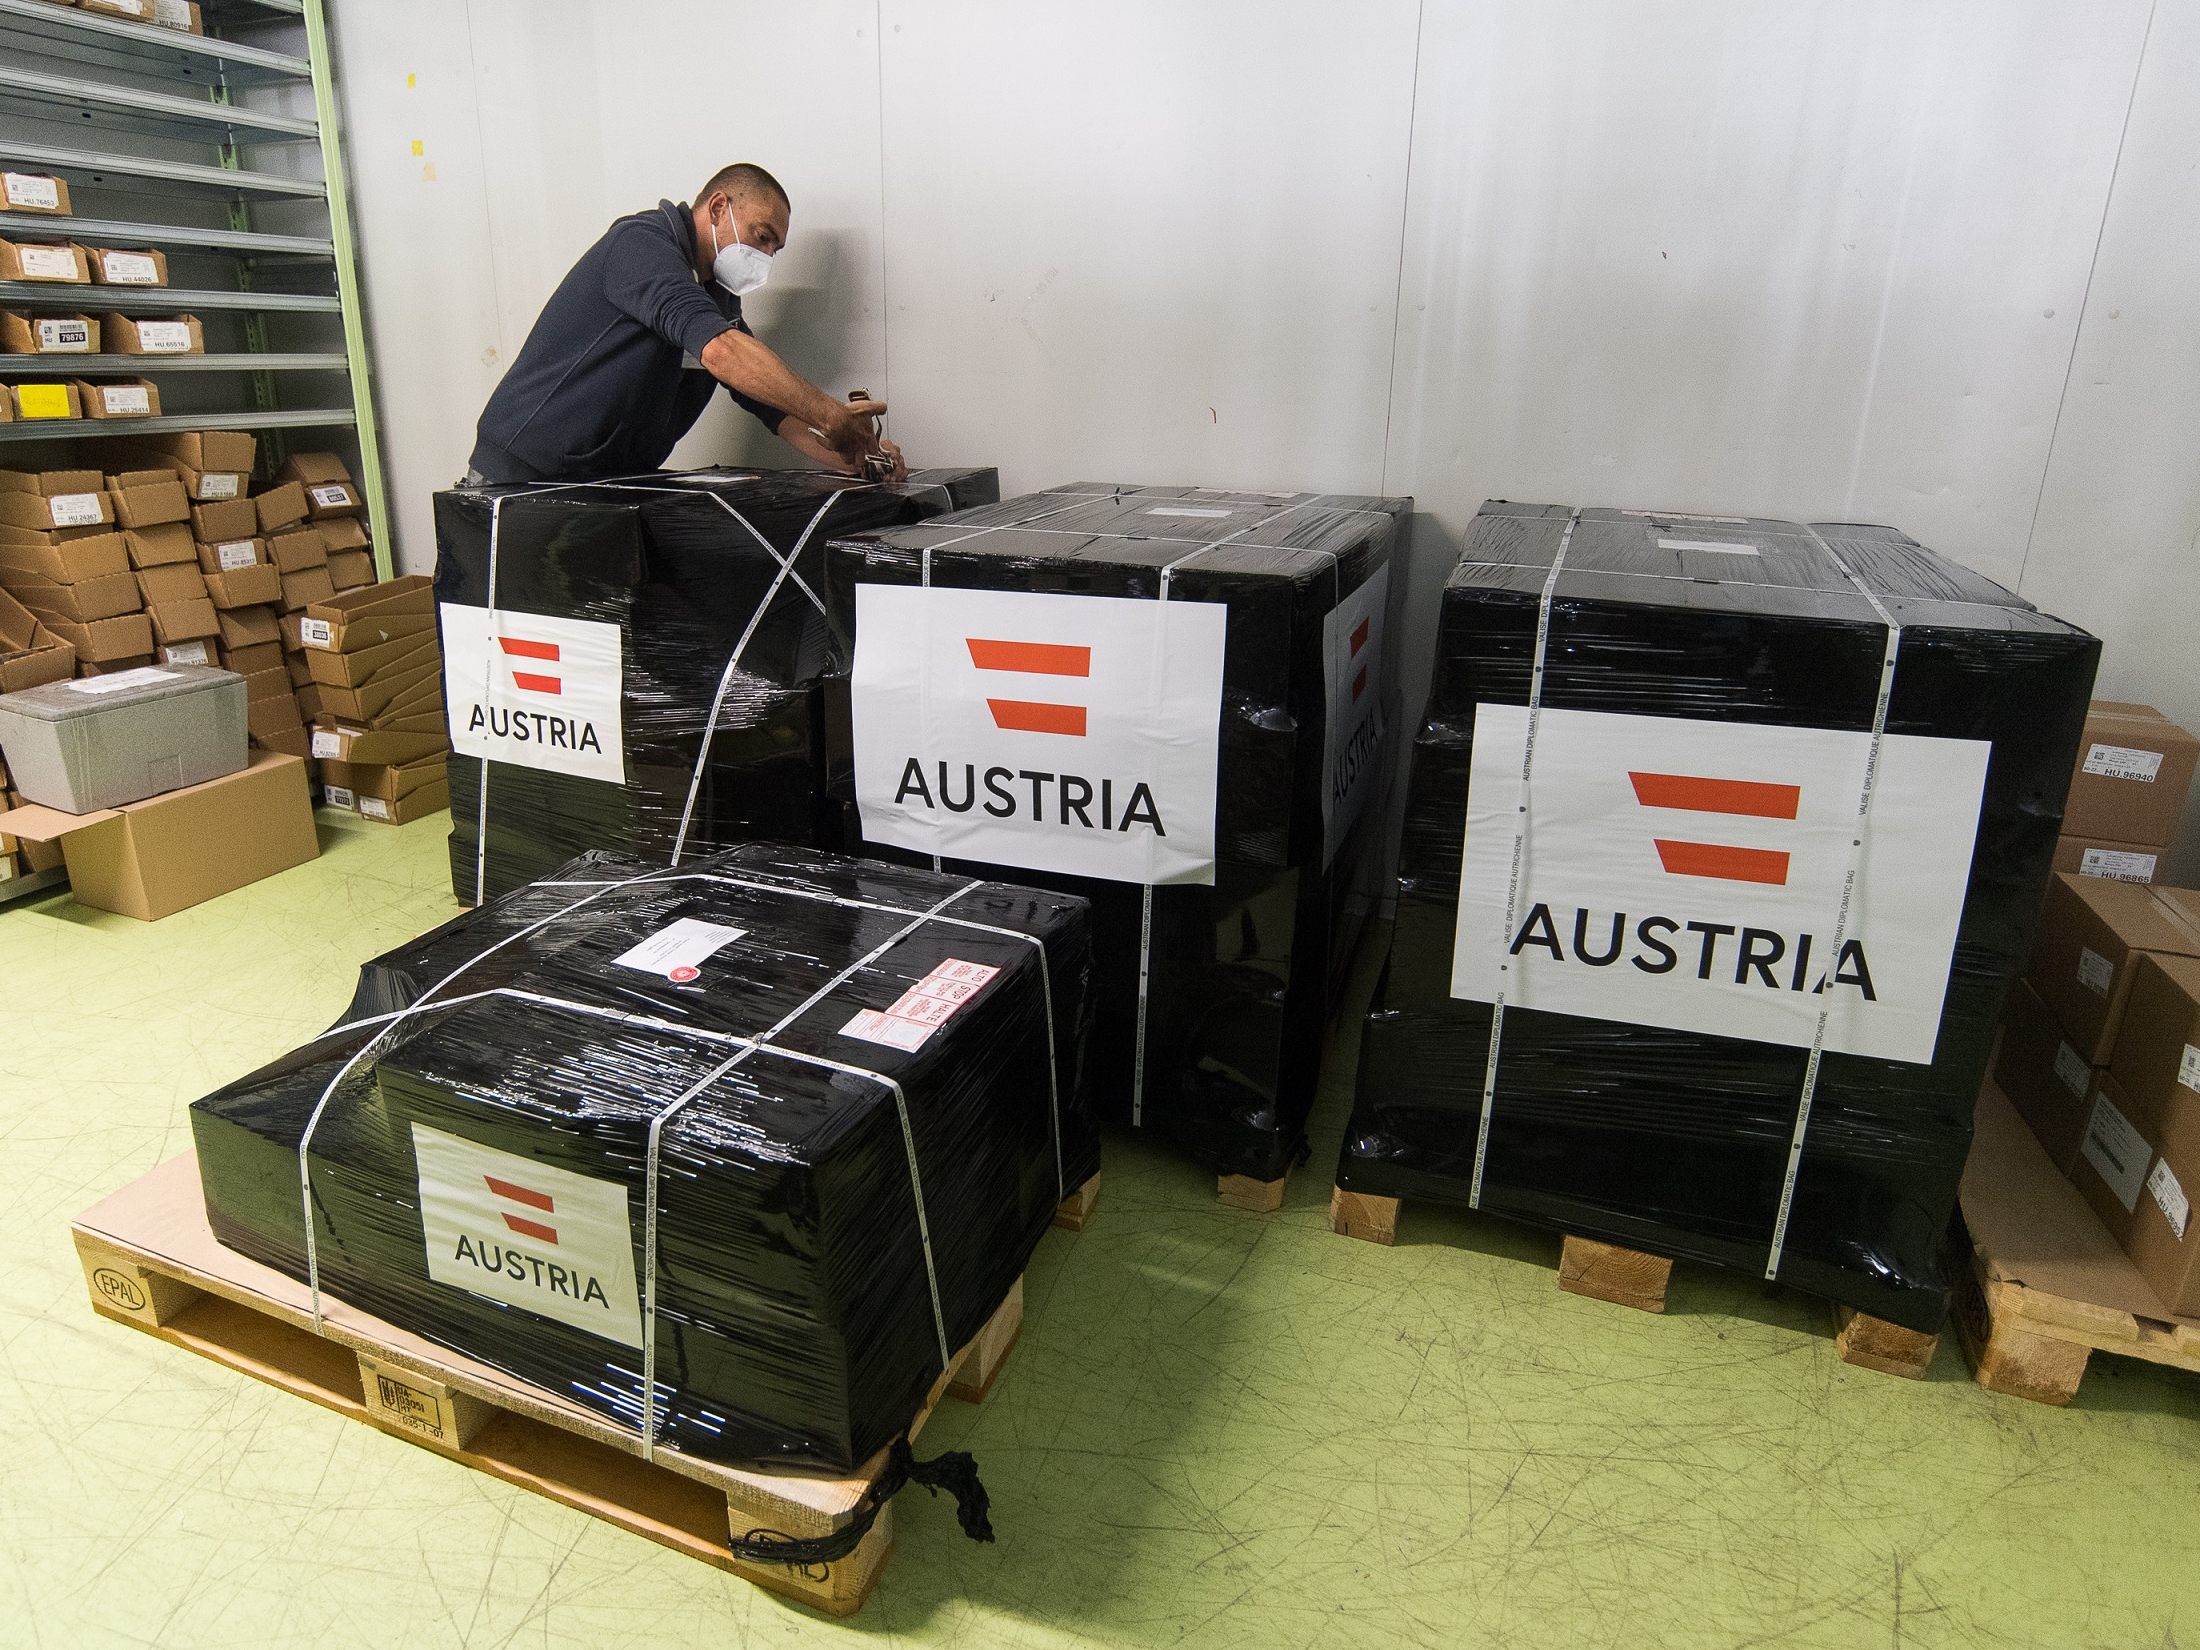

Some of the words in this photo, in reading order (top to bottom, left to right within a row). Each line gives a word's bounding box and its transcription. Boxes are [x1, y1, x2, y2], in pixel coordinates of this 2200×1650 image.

[61, 333, 84, 342] 79876
[469, 704, 602, 755] AUSTRIA
[1526, 710, 1536, 749] DIPLOMATIC
[1872, 690, 1888, 740] AUTRICHIENNE
[1334, 708, 1378, 805] AUSTRIA
[1523, 749, 1532, 781] AUSTRIAN
[1862, 740, 1879, 790] DIPLOMATIQUE
[895, 757, 1166, 836] AUSTRIA
[1858, 791, 1869, 816] VALISE
[1845, 868, 1855, 884] BAG
[2101, 872, 2150, 883] HU.96865
[1506, 877, 1517, 921] DIPLOMATIQUE
[1837, 883, 1852, 924] DIPLOMATIC
[1503, 922, 1512, 944] VALISE
[1831, 923, 1844, 956] AUSTRIAN
[1509, 902, 1877, 1002] AUSTRIA
[952, 986, 971, 999] STOP
[972, 969, 990, 981] ALTO
[927, 1004, 951, 1022] HALTE
[1496, 990, 1504, 1005] BAG
[1492, 1004, 1503, 1039] DIPLOMATIC
[1812, 1009, 1828, 1055] AUTRICHIENNE
[1488, 1039, 1498, 1068] AUSTRIAN
[1803, 1055, 1818, 1100] DIPLOMATIQUE
[1798, 1100, 1809, 1122] VALISE
[648, 1146, 656, 1173] VALISE
[647, 1175, 655, 1229] DIPLOMATIQUE
[1773, 1217, 1786, 1248] AUSTRIAN
[1780, 1182, 1792, 1219] DIPLOMATIC
[1786, 1169, 1795, 1183] BAG
[454, 1234, 610, 1310] AUSTRIA
[646, 1228, 654, 1281] AUTRICHIENNE
[100, 1273, 141, 1306] EPAL
